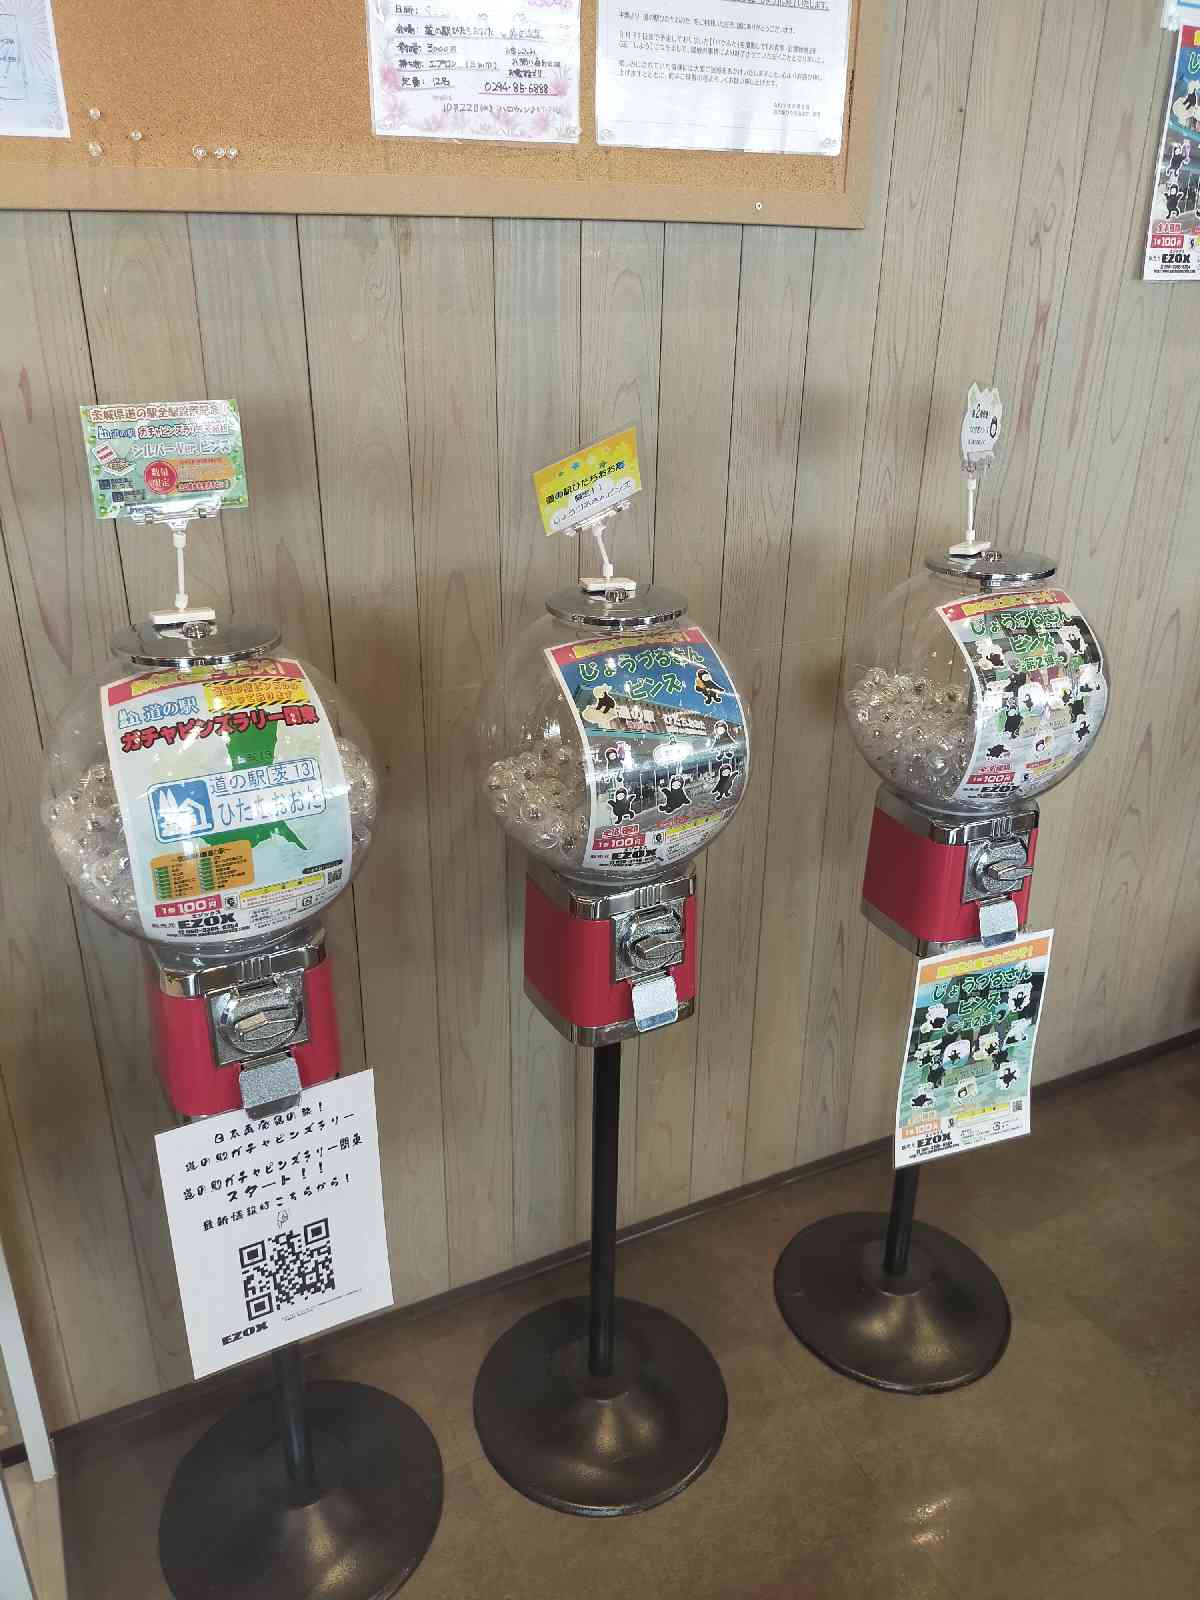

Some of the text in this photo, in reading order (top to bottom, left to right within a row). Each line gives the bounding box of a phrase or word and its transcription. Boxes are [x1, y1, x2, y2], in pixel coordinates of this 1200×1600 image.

[1161, 253, 1191, 264] EZOX
[144, 696, 199, 722] 道の駅
[209, 769, 265, 794] 道の駅
[611, 848, 657, 861] EZOX
[177, 911, 237, 930] EZOX
[916, 1132, 952, 1149] EZOX
[221, 1321, 269, 1346] EZOX
